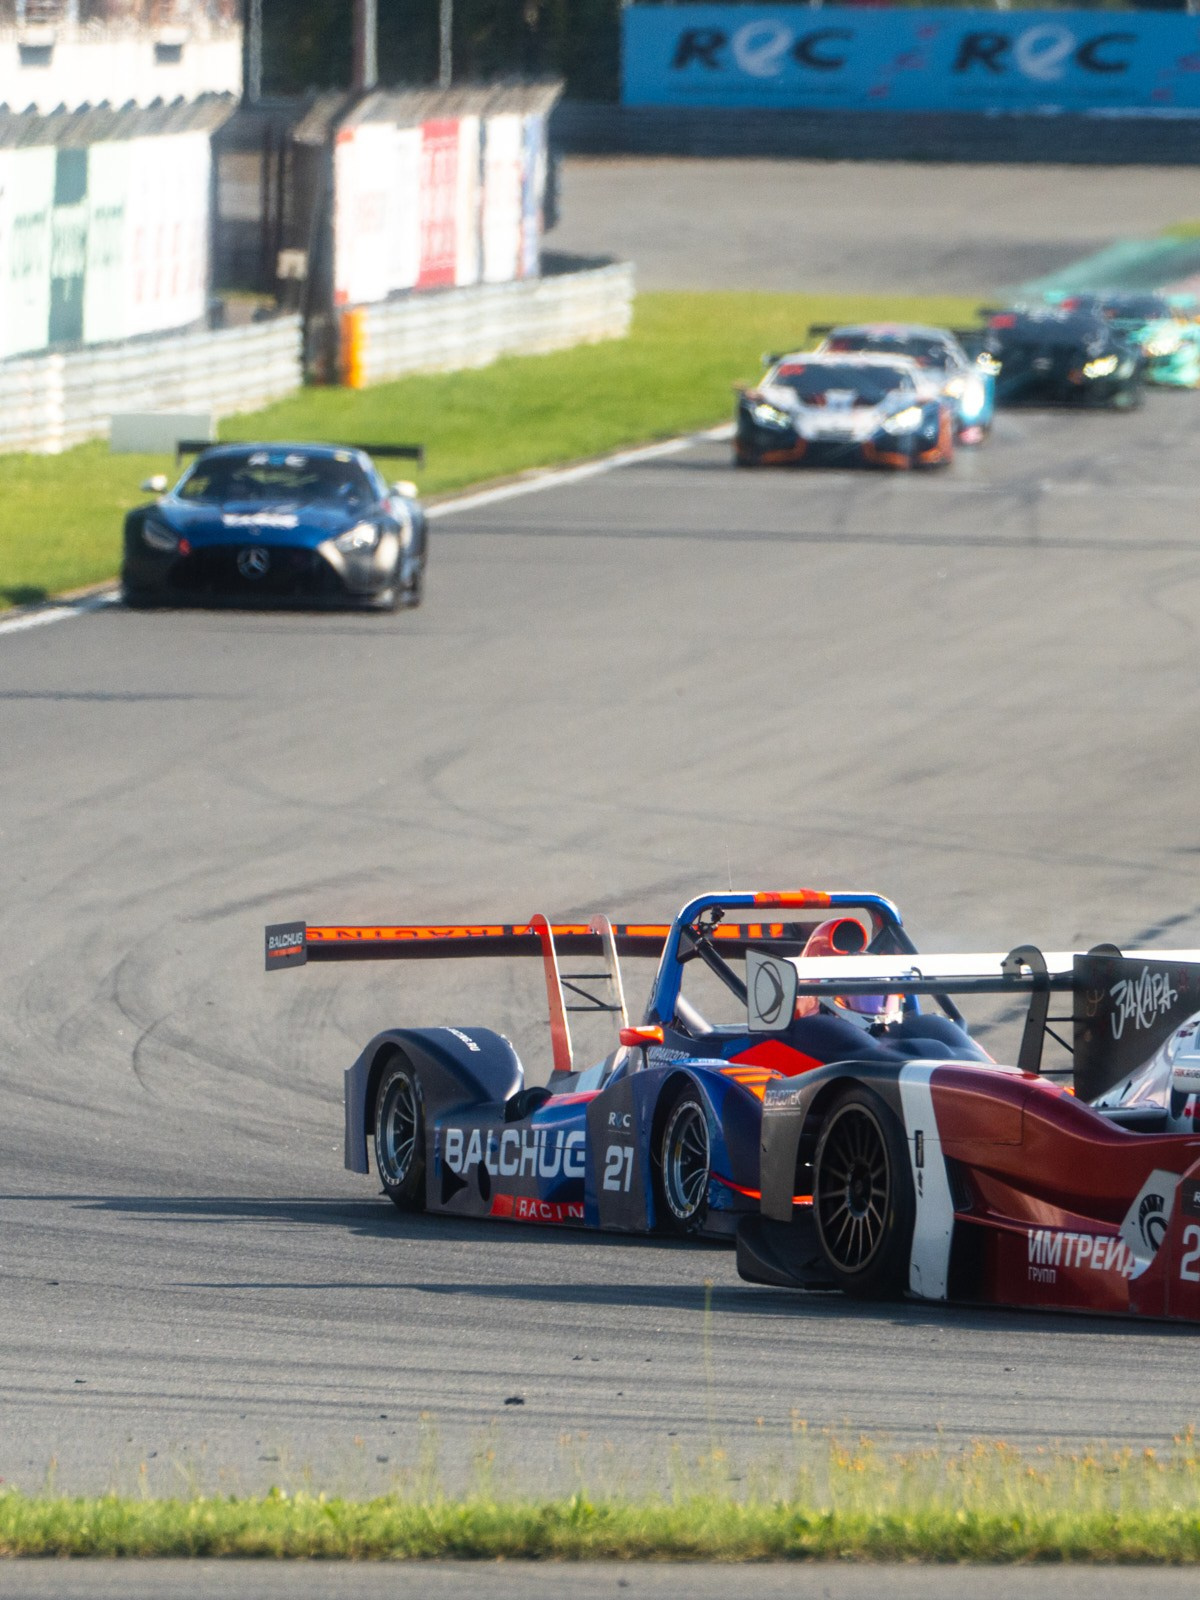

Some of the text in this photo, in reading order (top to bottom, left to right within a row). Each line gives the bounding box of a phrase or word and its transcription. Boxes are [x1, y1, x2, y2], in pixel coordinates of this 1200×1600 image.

[268, 932, 303, 949] BALCHUG
[445, 1128, 585, 1178] BALCHUG
[603, 1145, 634, 1193] 21
[1027, 1266, 1056, 1284] ГРУПП
